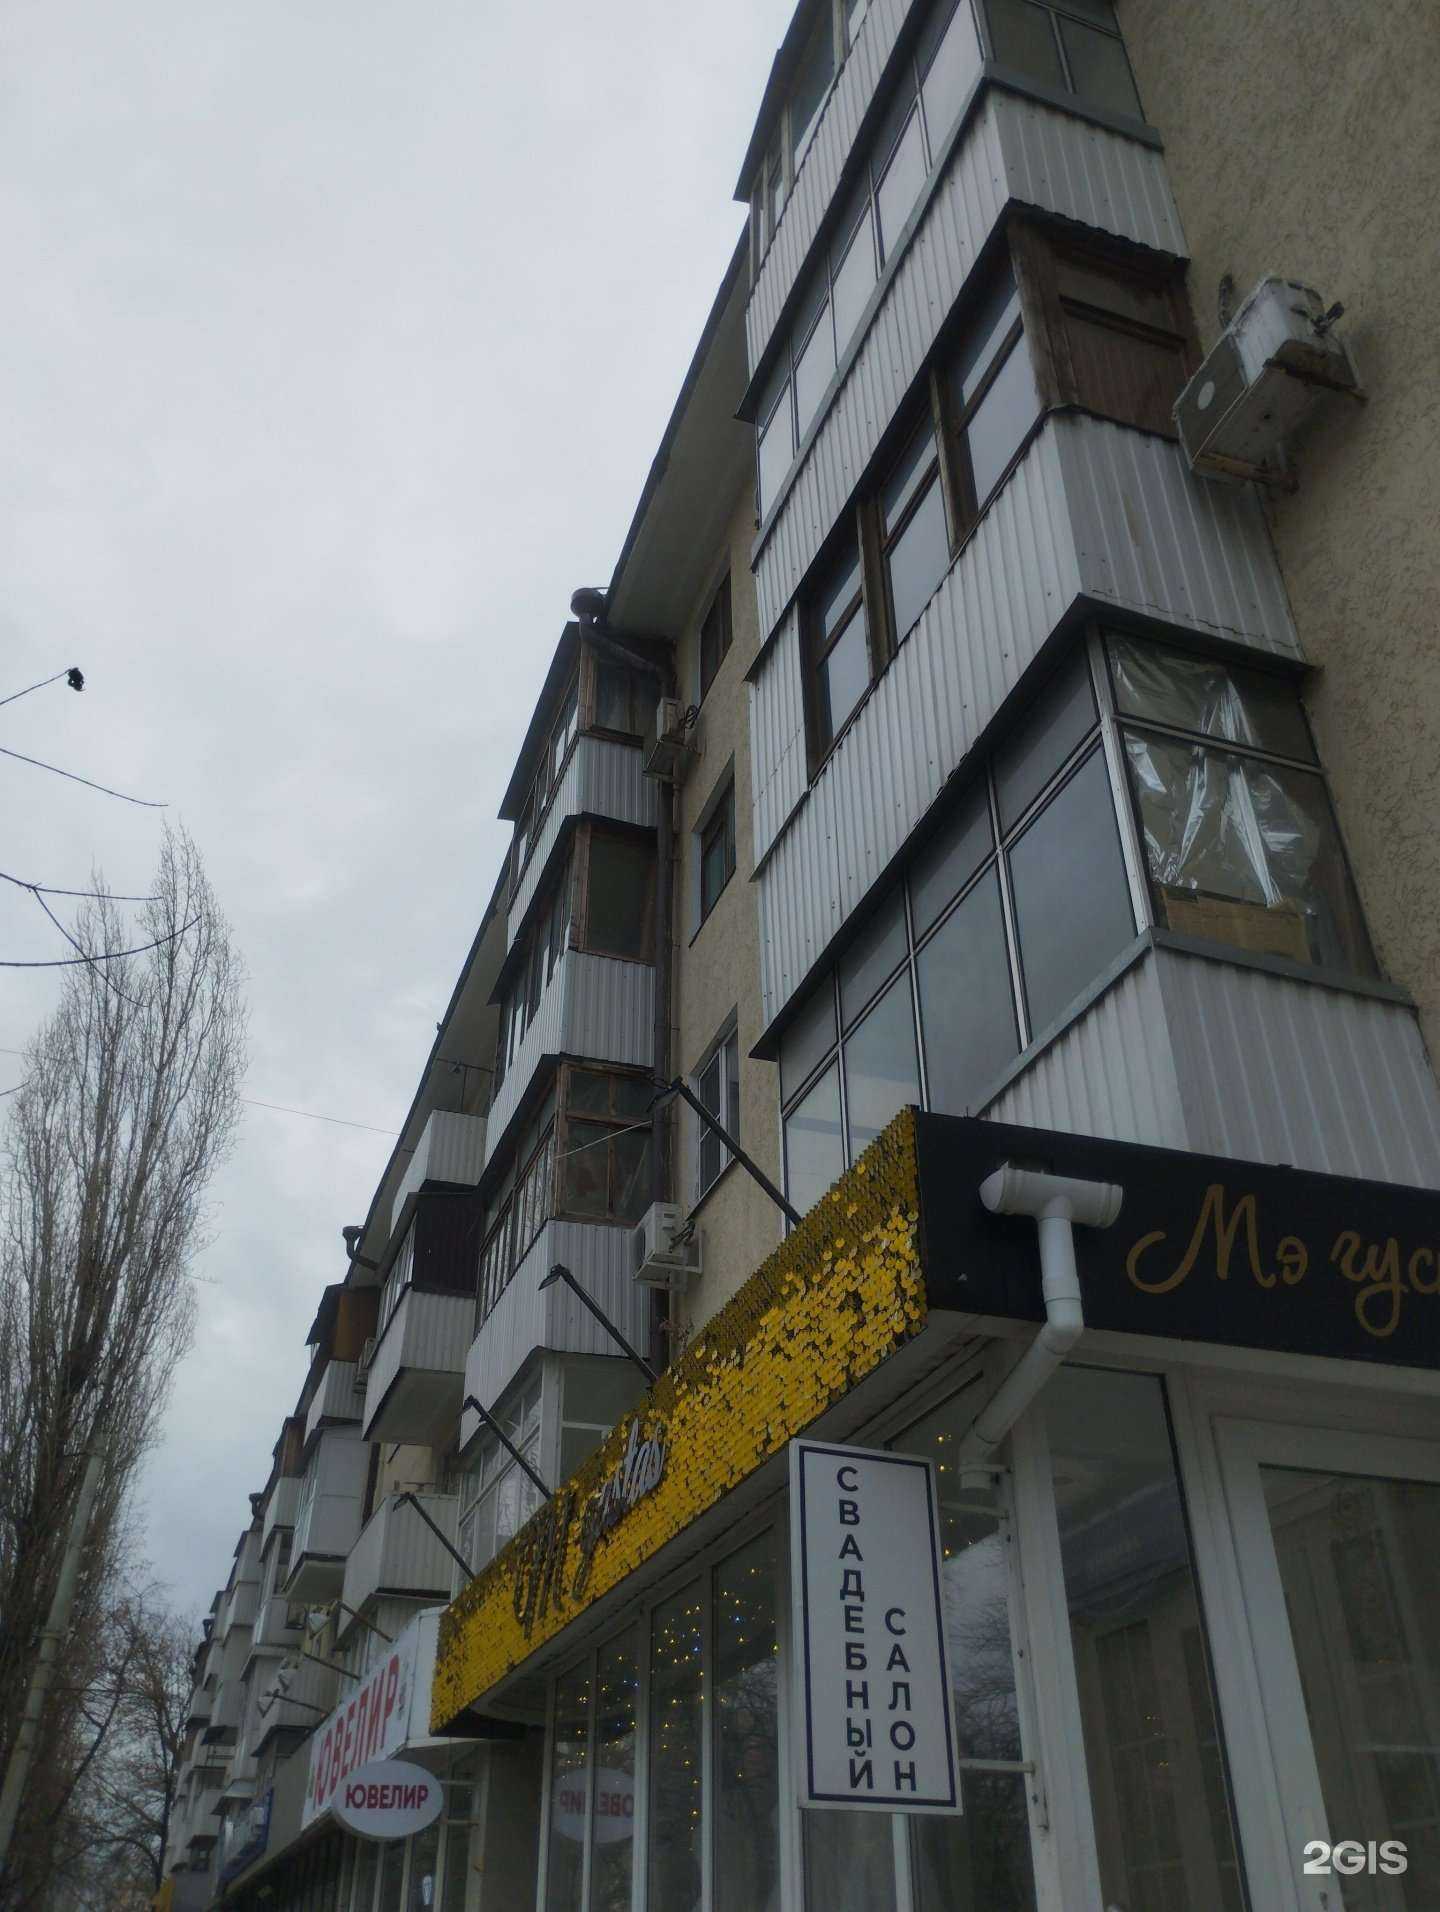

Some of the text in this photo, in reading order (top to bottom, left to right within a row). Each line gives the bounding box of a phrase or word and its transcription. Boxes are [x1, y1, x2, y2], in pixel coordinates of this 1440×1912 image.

[1330, 1230, 1440, 1338] гус
[836, 1465, 875, 1791] СВАДЕБНЫЙ
[885, 1606, 917, 1792] САЛОН
[345, 1783, 429, 1810] ЮВЕЛИР
